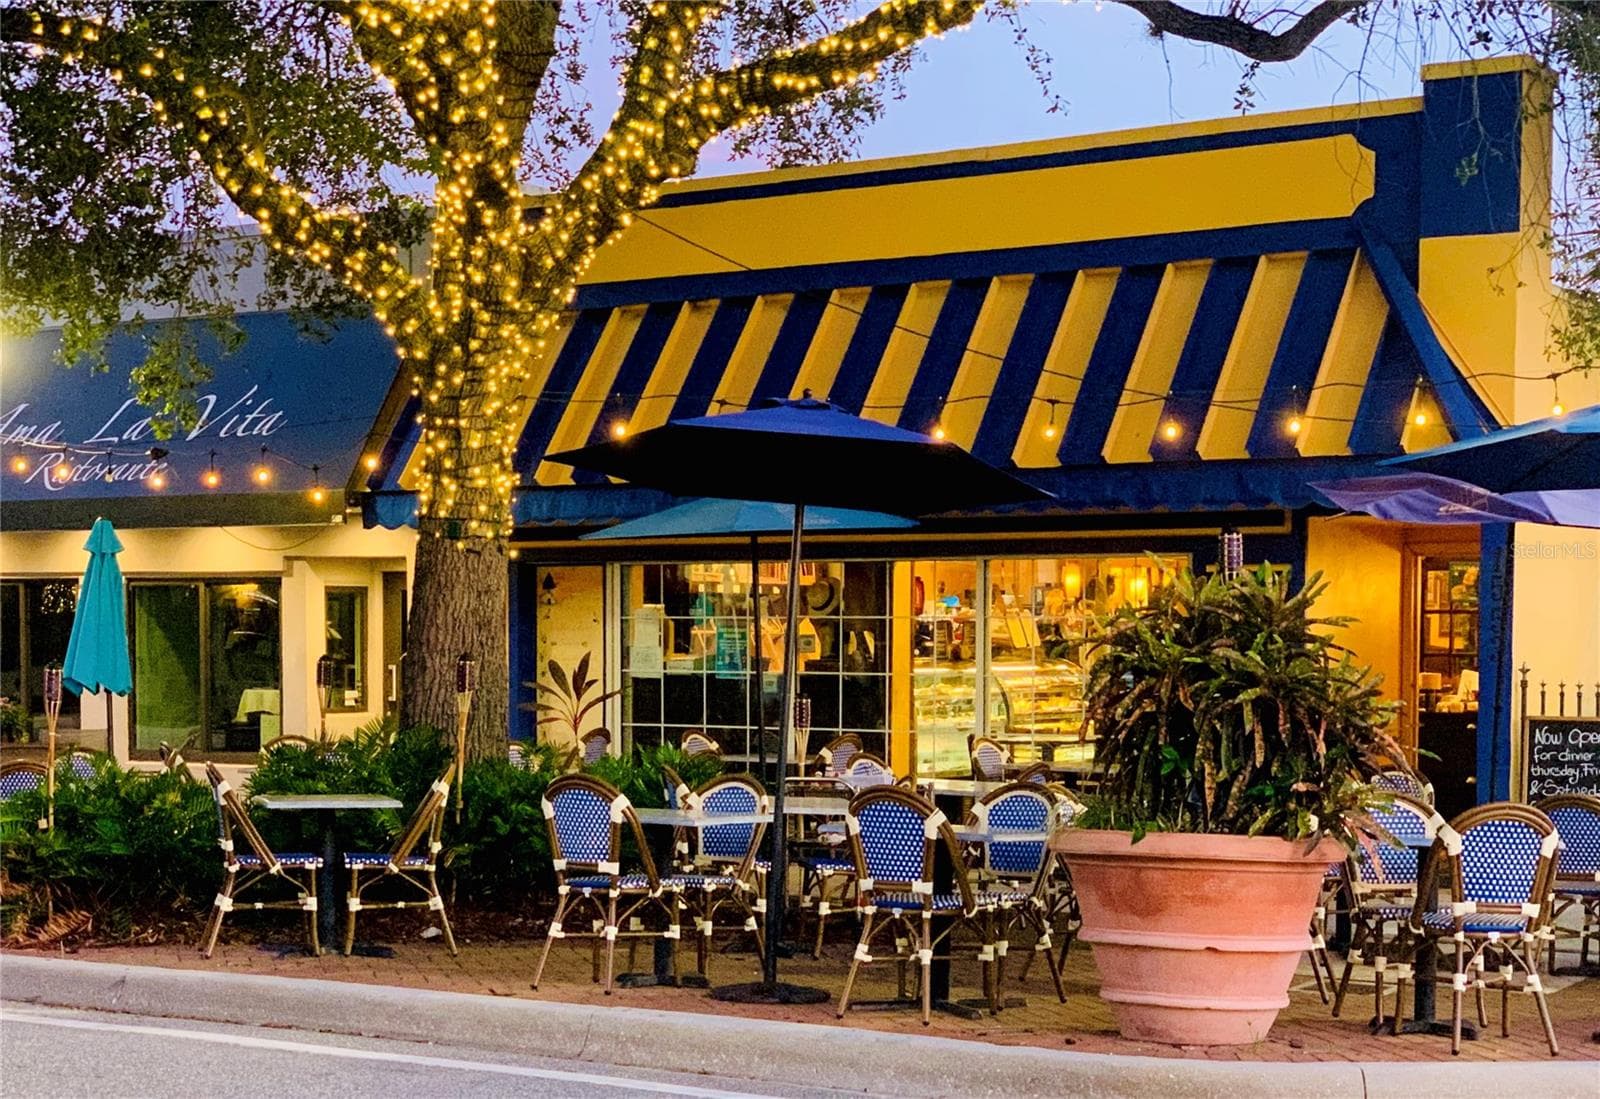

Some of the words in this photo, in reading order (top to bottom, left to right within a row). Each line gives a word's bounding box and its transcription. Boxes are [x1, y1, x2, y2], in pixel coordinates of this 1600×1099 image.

[0, 403, 65, 446] Ama
[83, 397, 153, 444] La
[185, 385, 288, 441] Vita
[24, 453, 168, 491] Ristorante
[1534, 726, 1562, 745] Now
[1568, 728, 1600, 748] Ope
[1534, 746, 1557, 763] for
[1558, 748, 1595, 761] dinner
[1581, 763, 1600, 777] Fri
[1530, 780, 1543, 795] &
